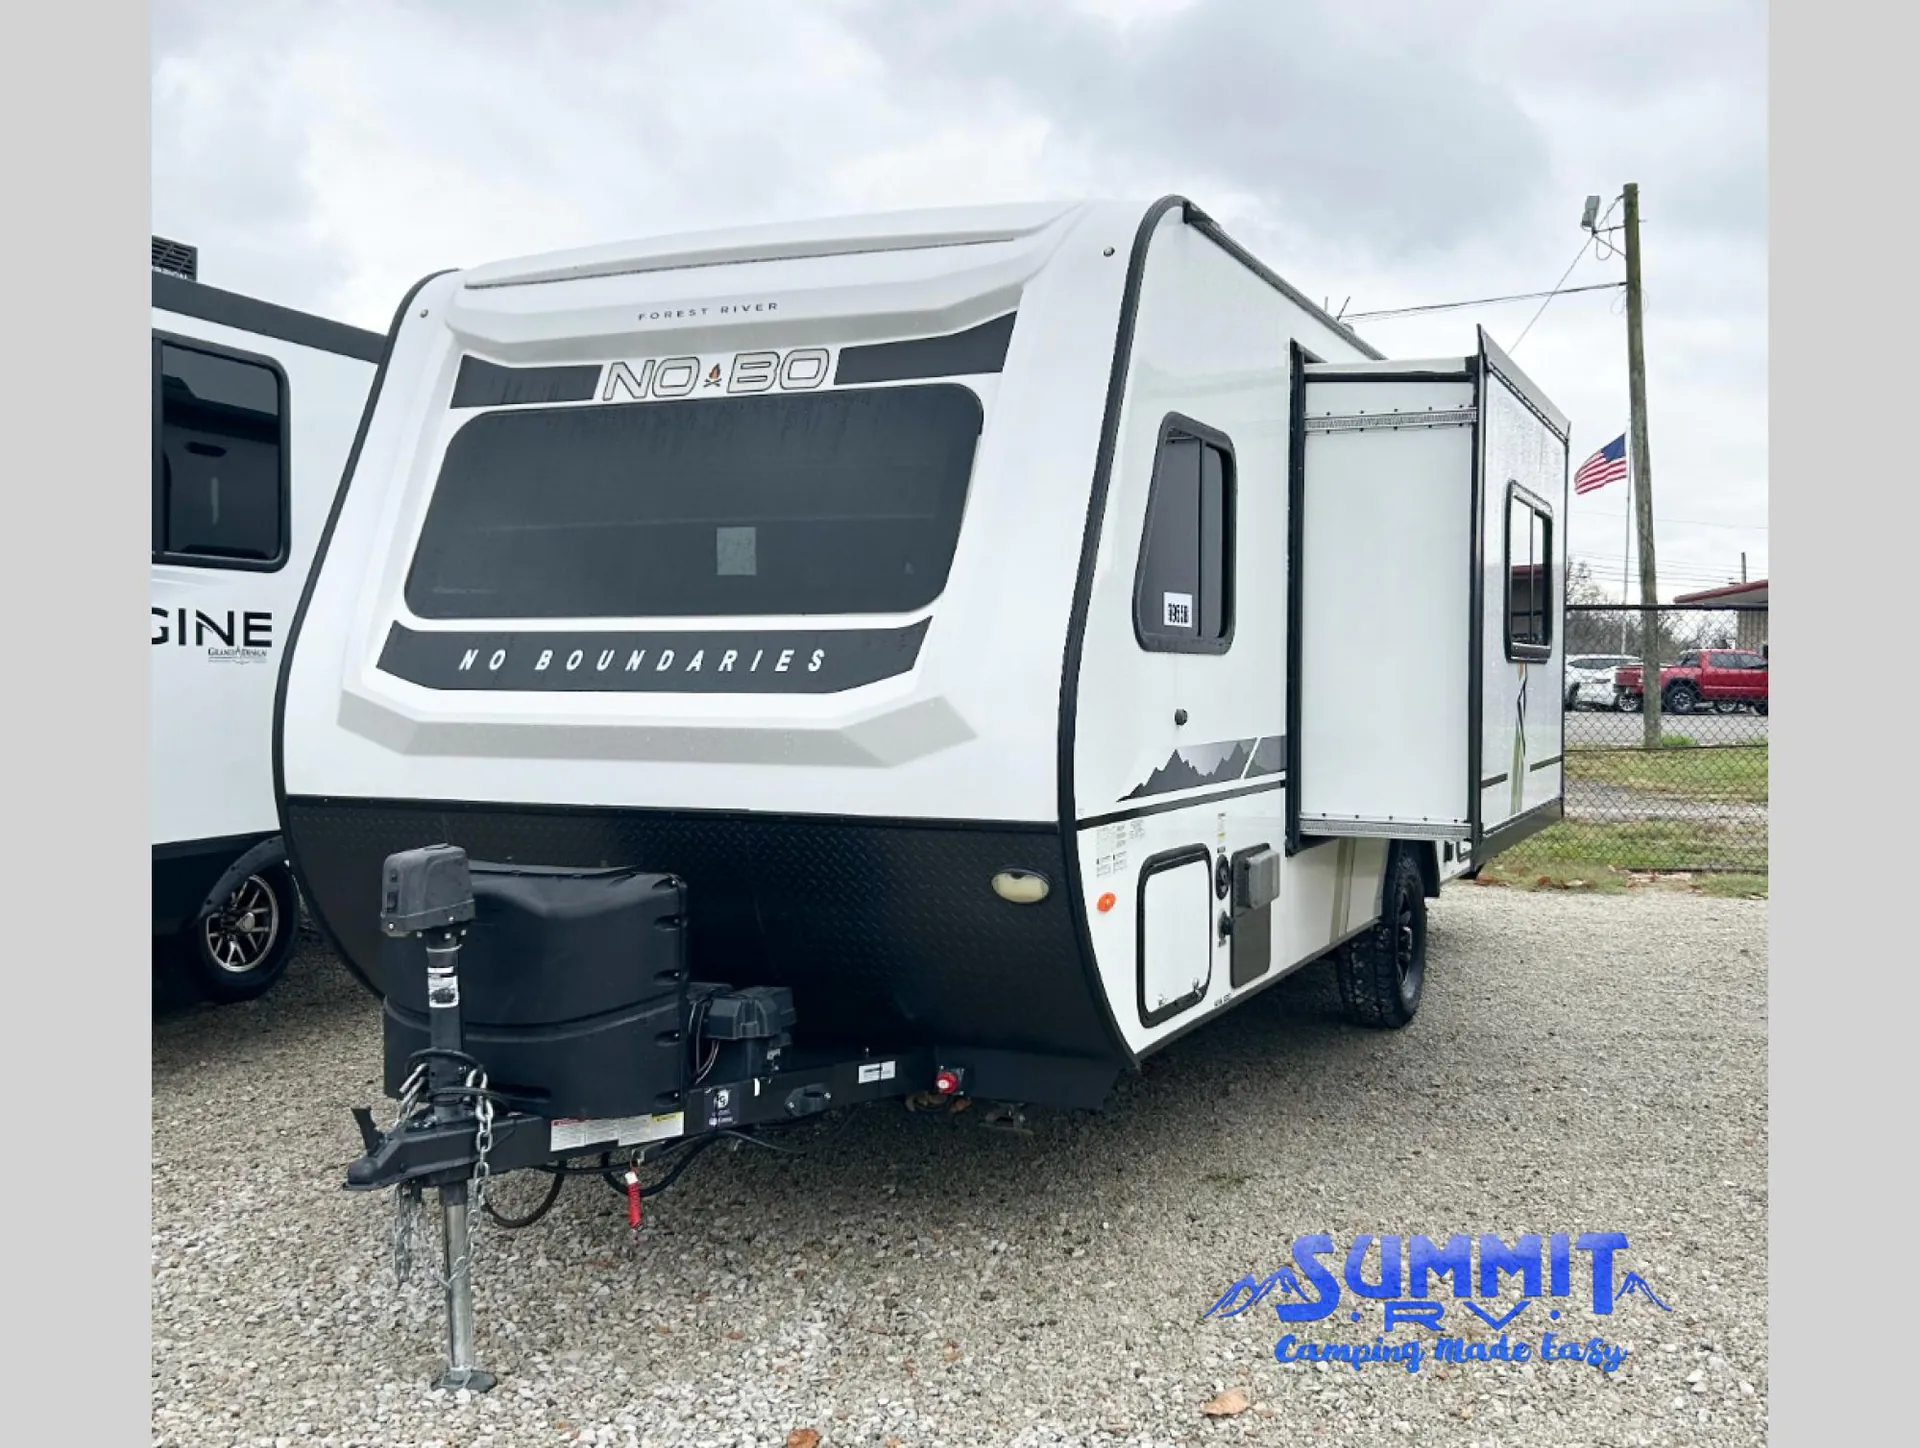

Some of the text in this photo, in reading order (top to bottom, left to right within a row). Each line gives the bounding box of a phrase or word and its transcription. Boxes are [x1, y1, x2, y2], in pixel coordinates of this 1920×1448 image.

[638, 302, 779, 321] FOREST RIVER
[458, 649, 826, 672] NO BOUNDARIES
